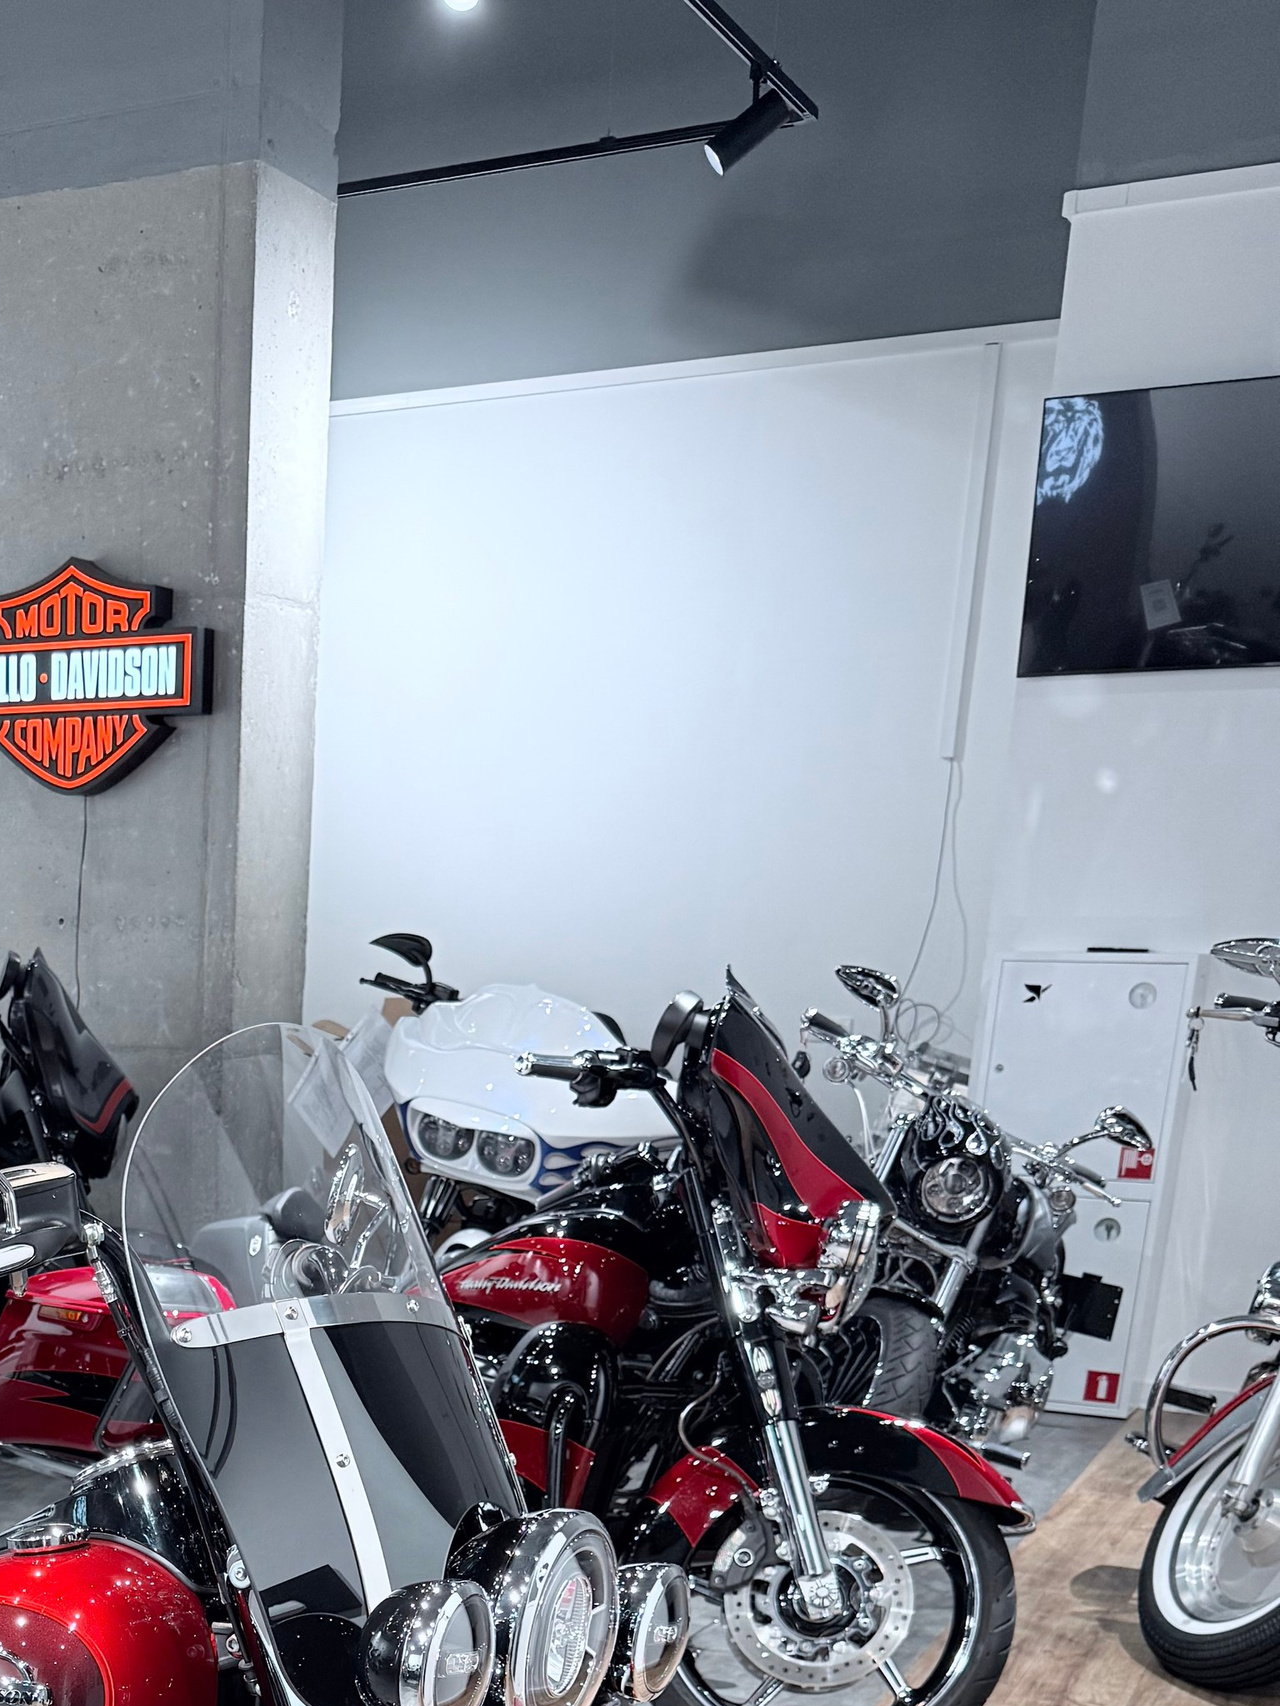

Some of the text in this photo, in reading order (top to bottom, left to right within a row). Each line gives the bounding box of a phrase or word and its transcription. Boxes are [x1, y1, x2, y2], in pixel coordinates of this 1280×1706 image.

[16, 582, 128, 638] MOTOR
[50, 645, 177, 701] DAVIDSON
[14, 714, 129, 778] COMPANY
